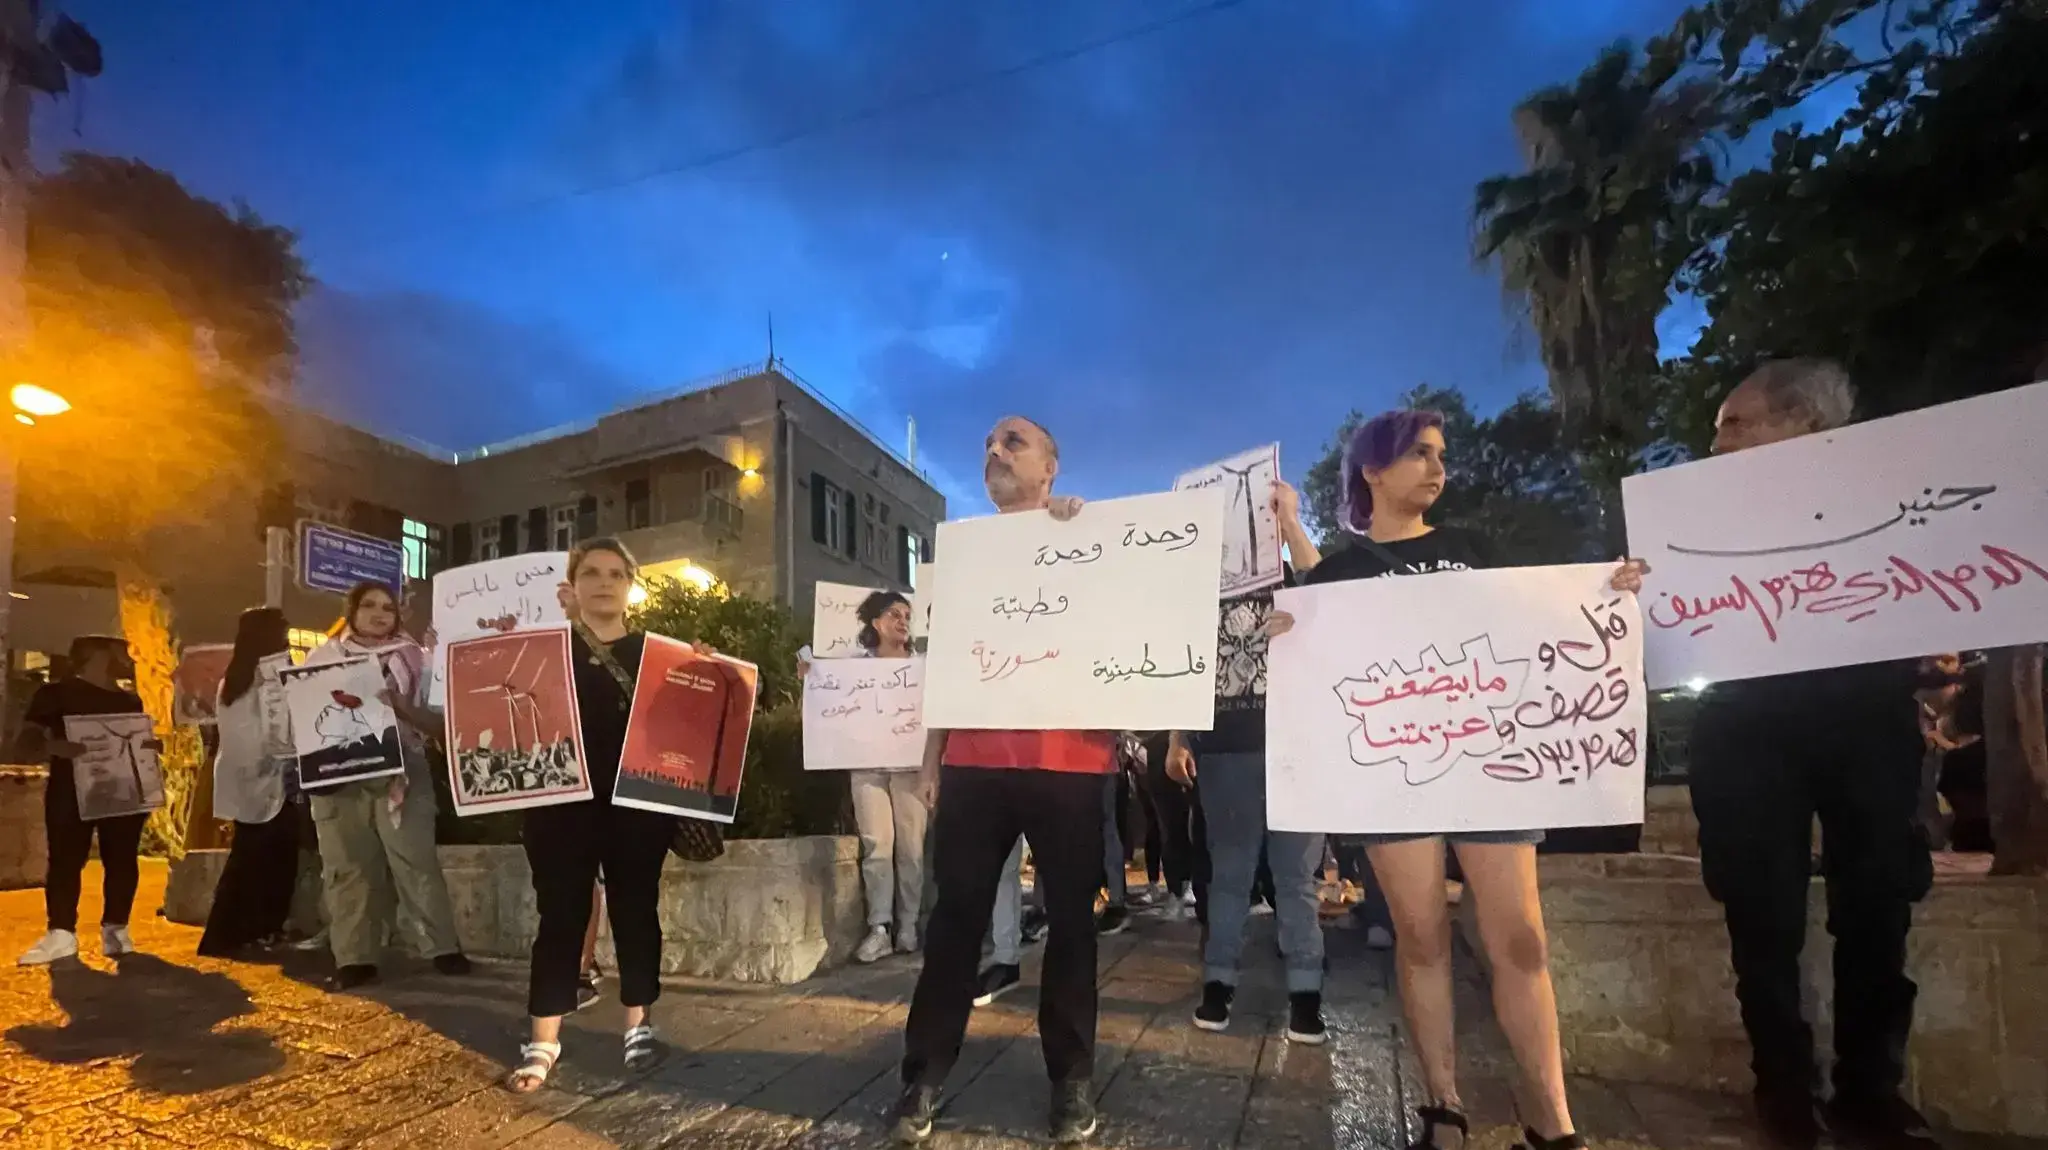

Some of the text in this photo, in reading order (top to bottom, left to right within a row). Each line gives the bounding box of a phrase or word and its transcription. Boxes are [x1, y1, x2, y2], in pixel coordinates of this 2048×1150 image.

[1034, 521, 1199, 566] وحدة وحدة
[1667, 483, 1998, 558] جنين
[1649, 543, 2048, 643] الدم الذي هزم السيف
[1538, 597, 1628, 672] قتل و
[1514, 666, 1629, 729] قصف
[1578, 727, 1637, 781] هدم
